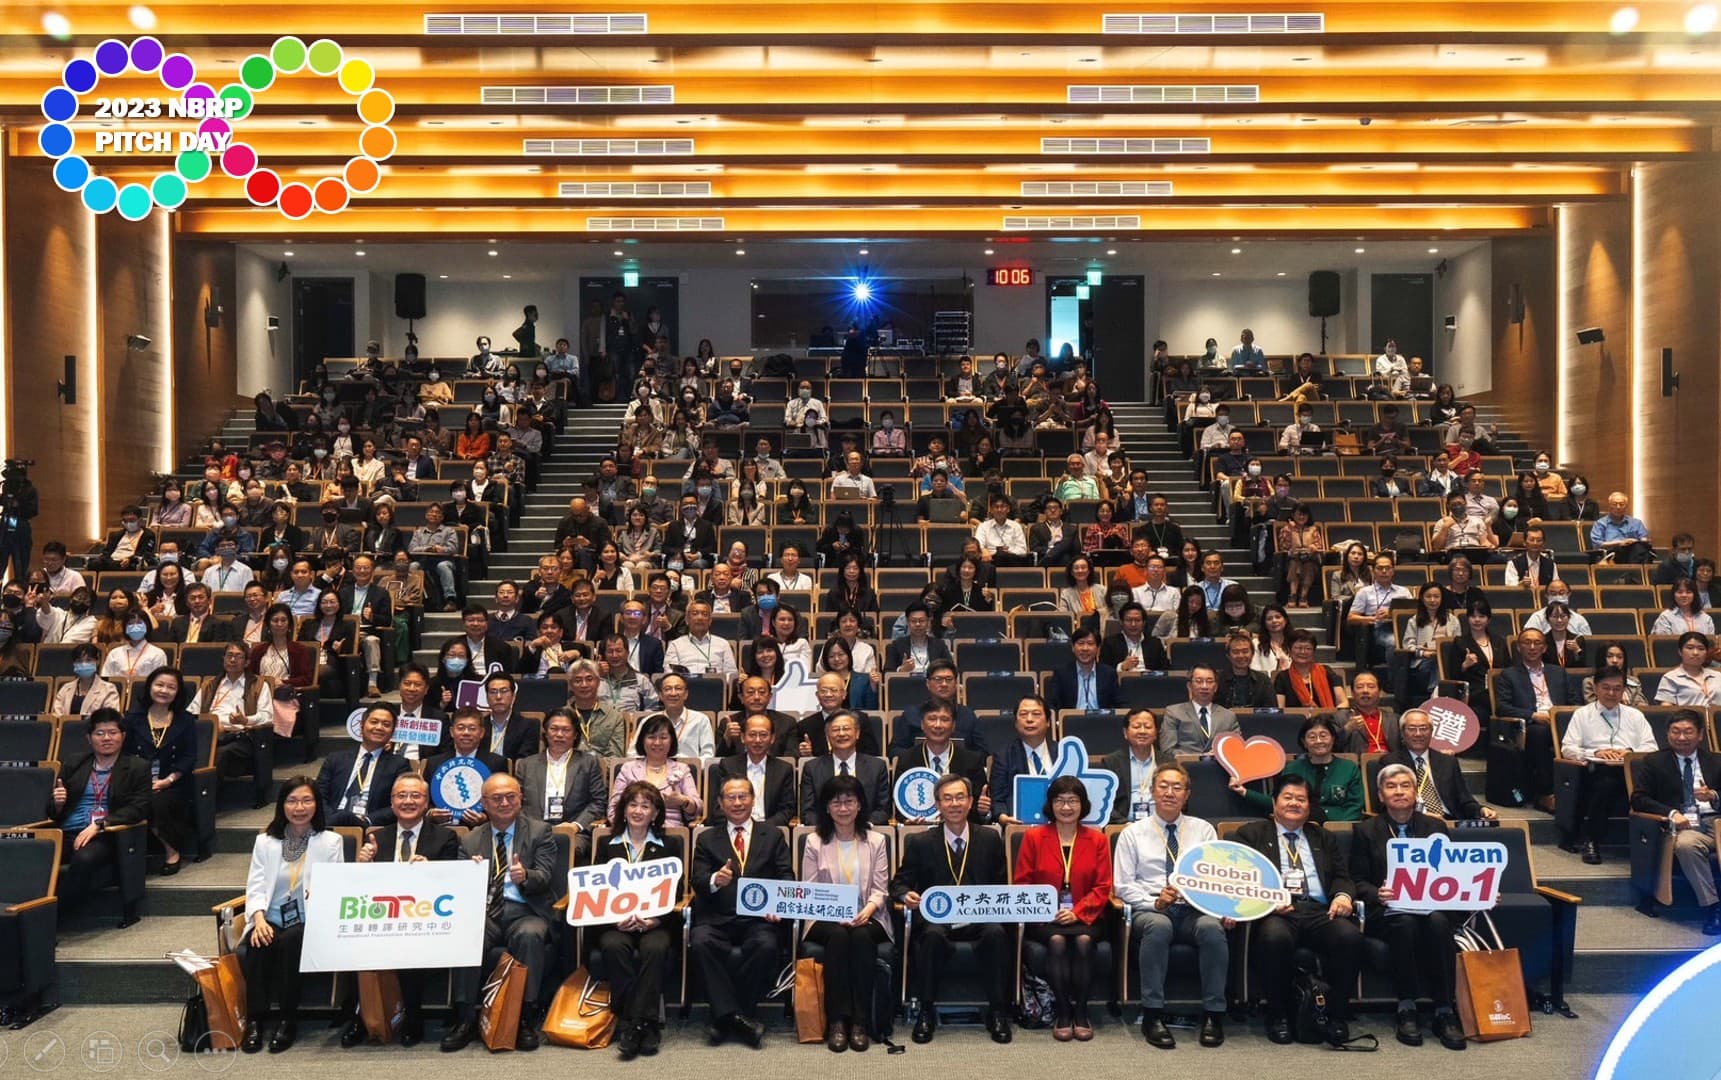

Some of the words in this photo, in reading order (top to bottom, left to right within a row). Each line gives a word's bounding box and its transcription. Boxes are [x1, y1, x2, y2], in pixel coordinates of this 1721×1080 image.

[395, 718, 440, 732] 新創搖籃
[1429, 706, 1466, 746] 讚
[1391, 838, 1503, 872] Taiwan
[572, 861, 678, 890] Taiwan
[1196, 863, 1258, 882] Global
[1391, 867, 1496, 902] No.1
[572, 878, 673, 920] No.1
[956, 892, 1052, 906] 中央研究院
[1176, 876, 1284, 901] connection
[956, 907, 1012, 916] ACADEMIA
[1016, 906, 1052, 915] SINICA
[338, 922, 452, 934] 生醫轉譯研究中心
